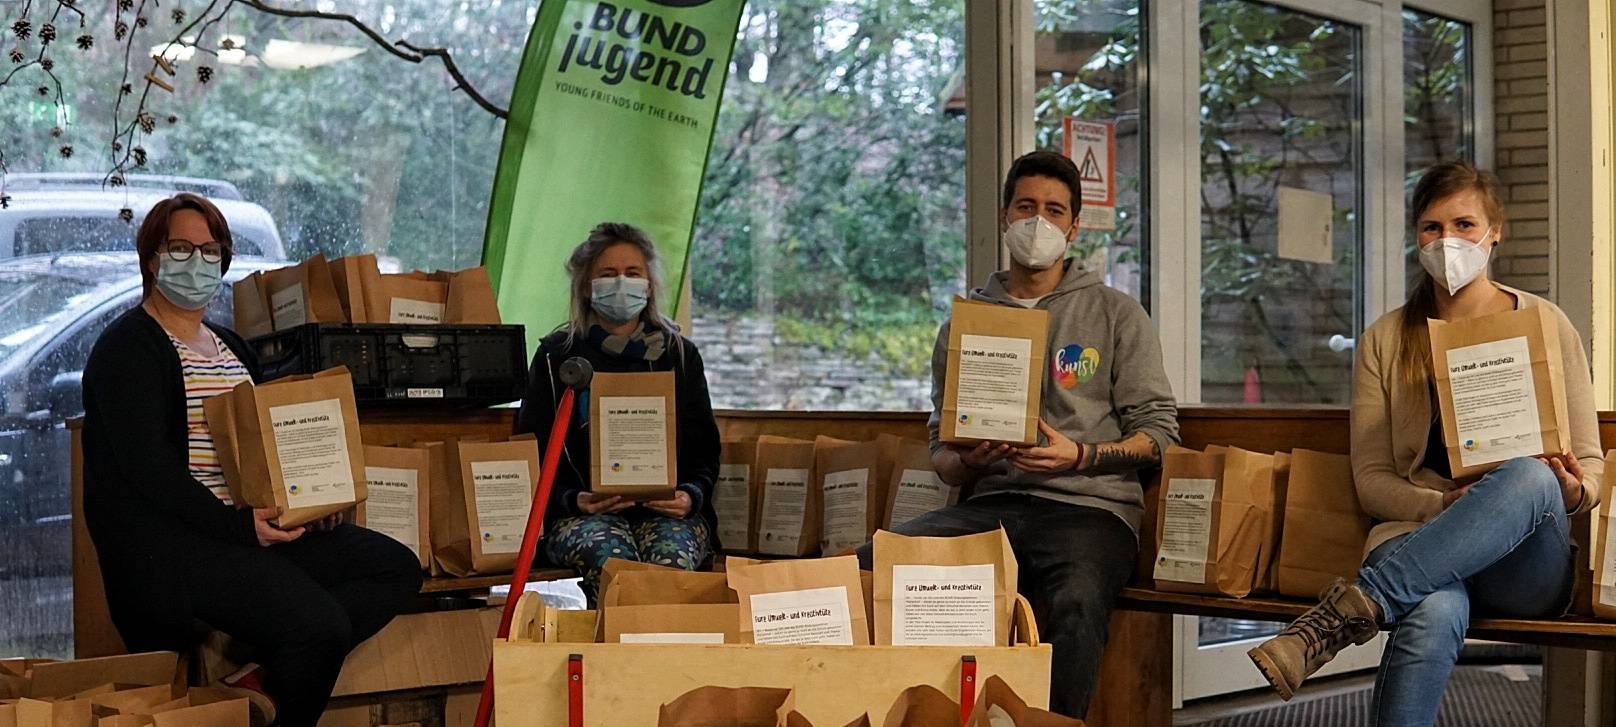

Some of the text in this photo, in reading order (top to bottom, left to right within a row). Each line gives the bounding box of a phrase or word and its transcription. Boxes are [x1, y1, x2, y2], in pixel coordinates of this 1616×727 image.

[590, 1, 706, 57] BUND
[558, 21, 714, 99] jugend
[555, 82, 698, 128] YOUNG FRIENDS OF THE EARTH
[1055, 348, 1098, 377] kunst
[941, 583, 951, 591] und
[790, 611, 800, 619] und
